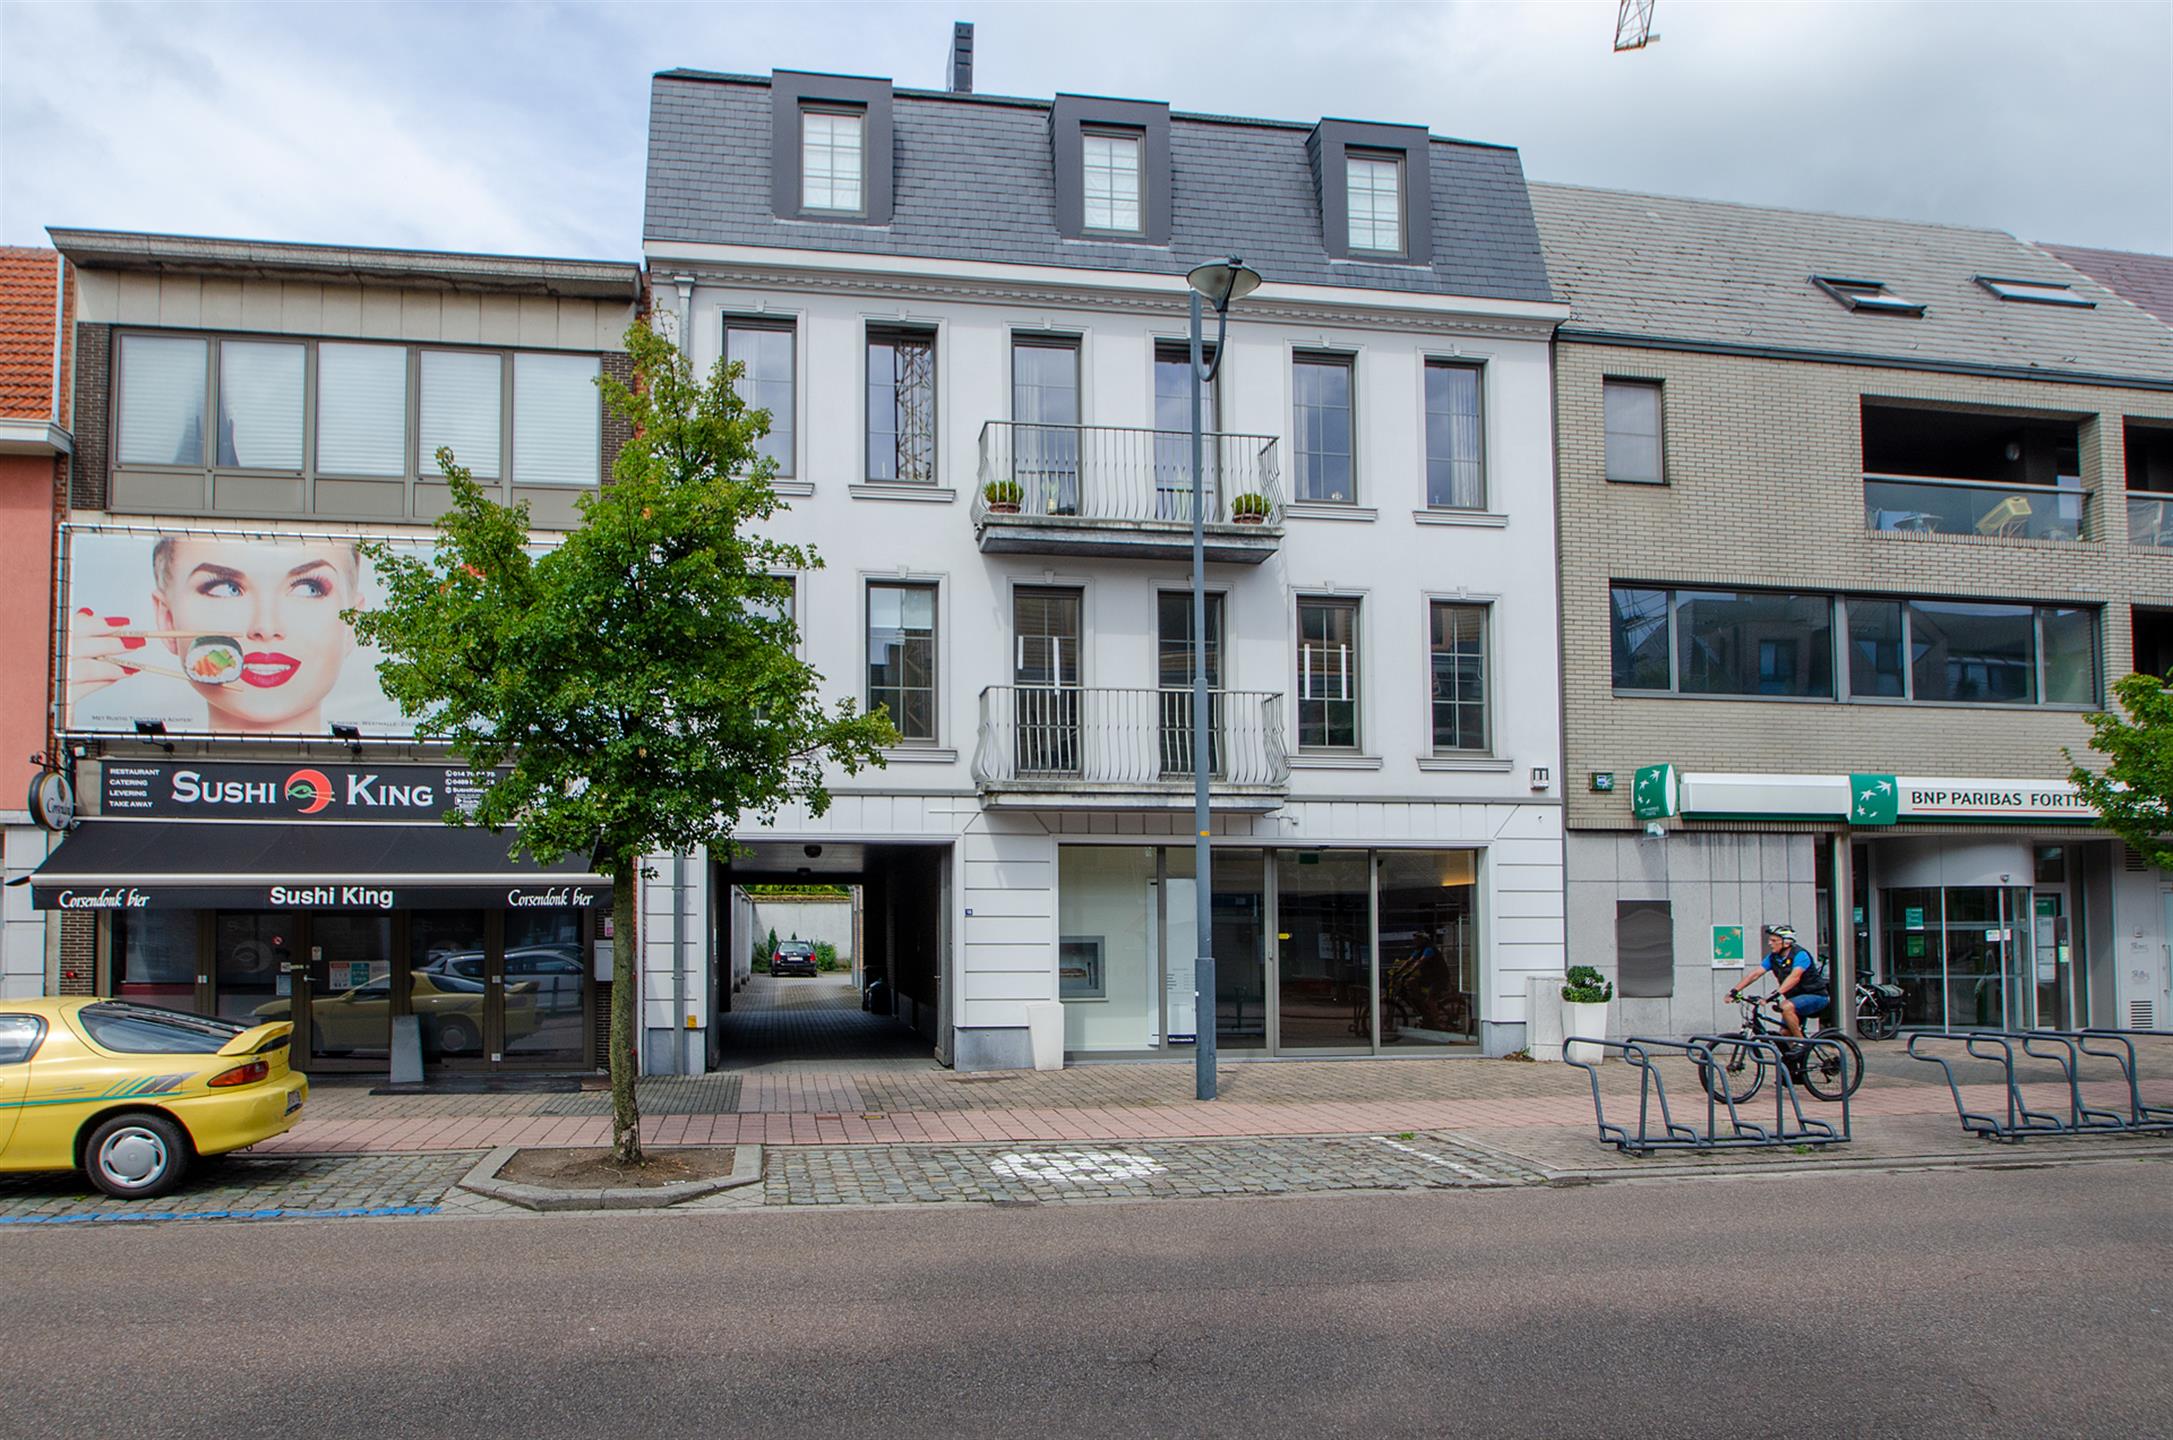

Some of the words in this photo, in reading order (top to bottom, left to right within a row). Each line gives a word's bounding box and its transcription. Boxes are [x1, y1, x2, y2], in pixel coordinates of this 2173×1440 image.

[109, 768, 160, 776] RESTAURANT
[109, 790, 147, 798] LEVERING
[171, 770, 277, 804] SUSHI
[346, 774, 434, 807] KING
[109, 800, 130, 808] TAKE
[1911, 791, 1947, 805] BNP
[1951, 792, 2022, 806] PARIBAS
[2031, 793, 2089, 807] FORTIS
[58, 888, 125, 908] Corsendonk
[126, 888, 150, 907] bier
[270, 886, 335, 905] Sushi
[342, 886, 394, 909] King
[508, 887, 570, 907] Corsendonk
[572, 887, 594, 906] bier
